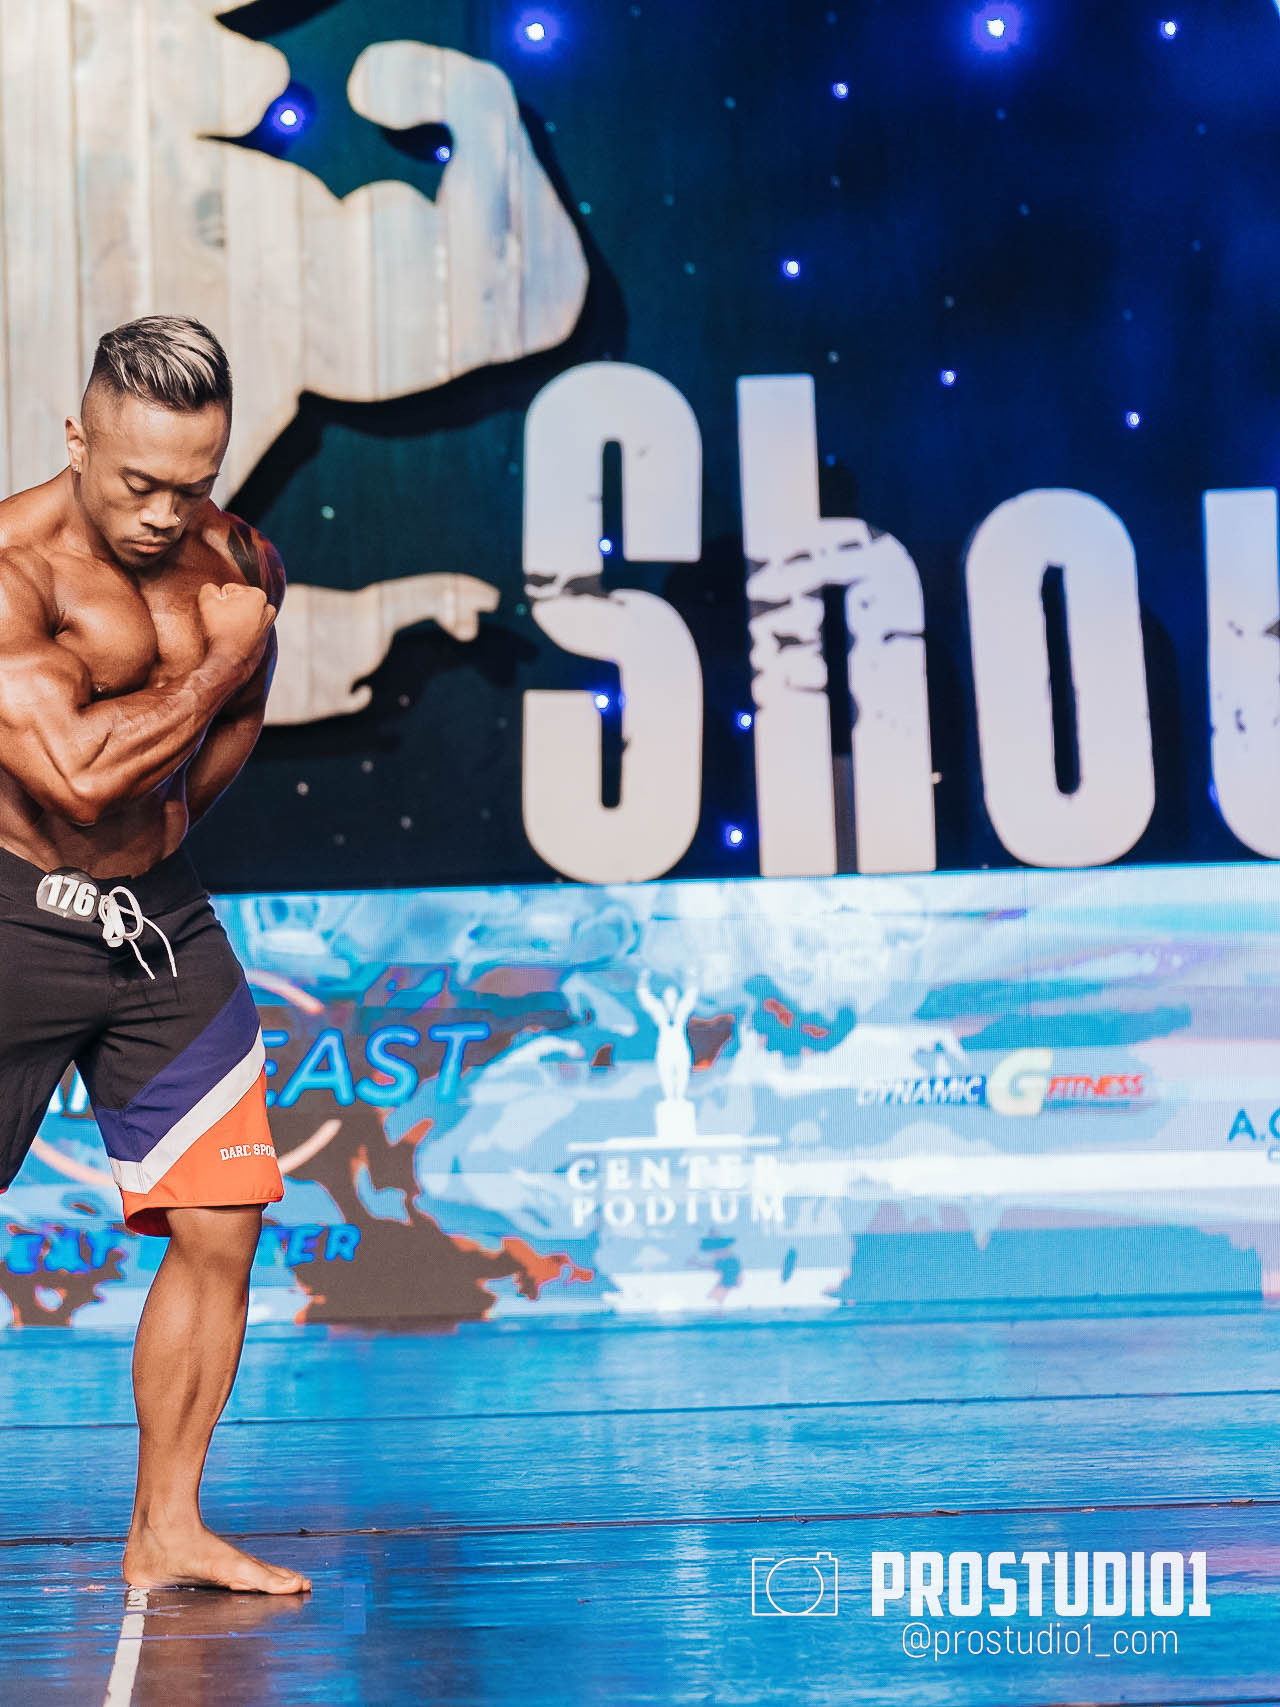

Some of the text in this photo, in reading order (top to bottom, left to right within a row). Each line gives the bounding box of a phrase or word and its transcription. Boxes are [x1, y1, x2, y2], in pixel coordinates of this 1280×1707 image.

[46, 874, 98, 917] 176
[567, 1153, 781, 1191] CENTER
[571, 1193, 787, 1229] PODIUM
